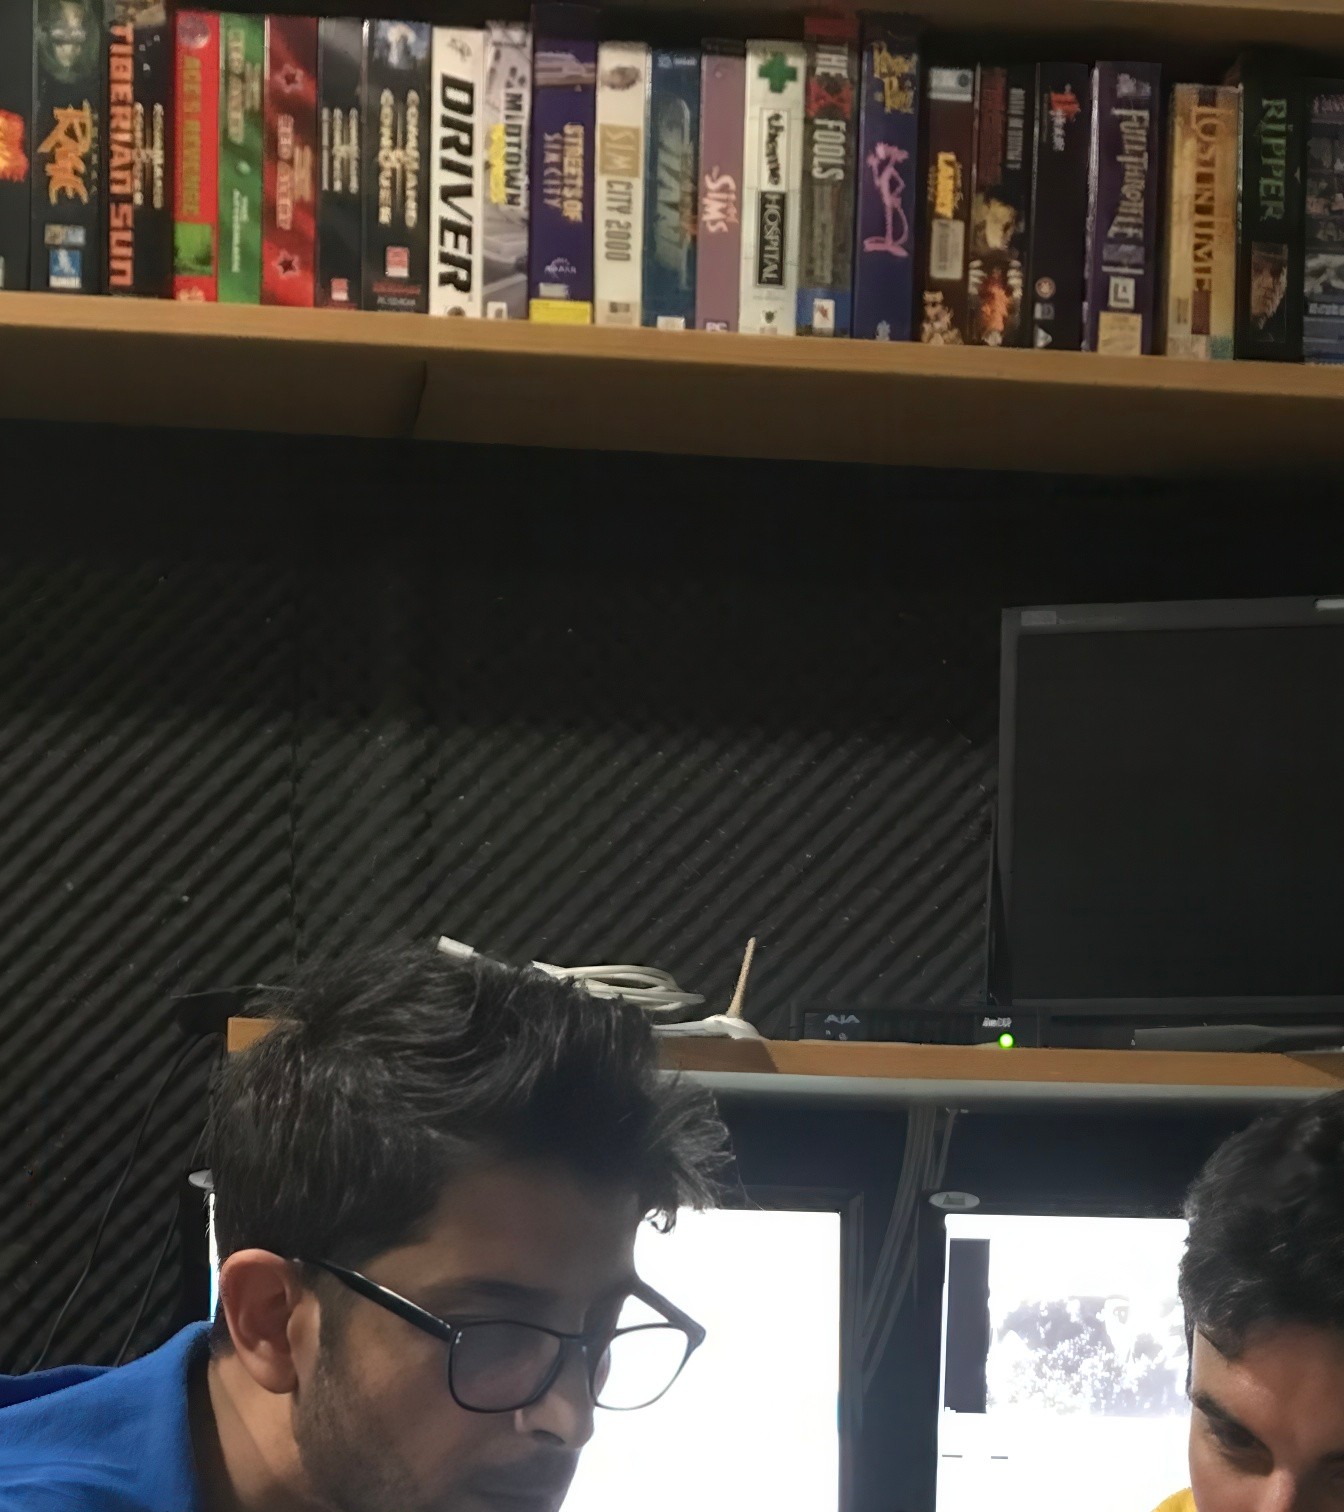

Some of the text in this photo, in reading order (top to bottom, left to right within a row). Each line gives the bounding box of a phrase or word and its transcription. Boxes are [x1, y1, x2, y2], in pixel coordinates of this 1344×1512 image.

[439, 73, 475, 296] DRIVER
[504, 92, 523, 208] MIDTOWN
[813, 119, 846, 182] FOOLS
[605, 219, 631, 263] 2000
[606, 180, 631, 214] CITY
[761, 113, 784, 283] theme HOSPITAL
